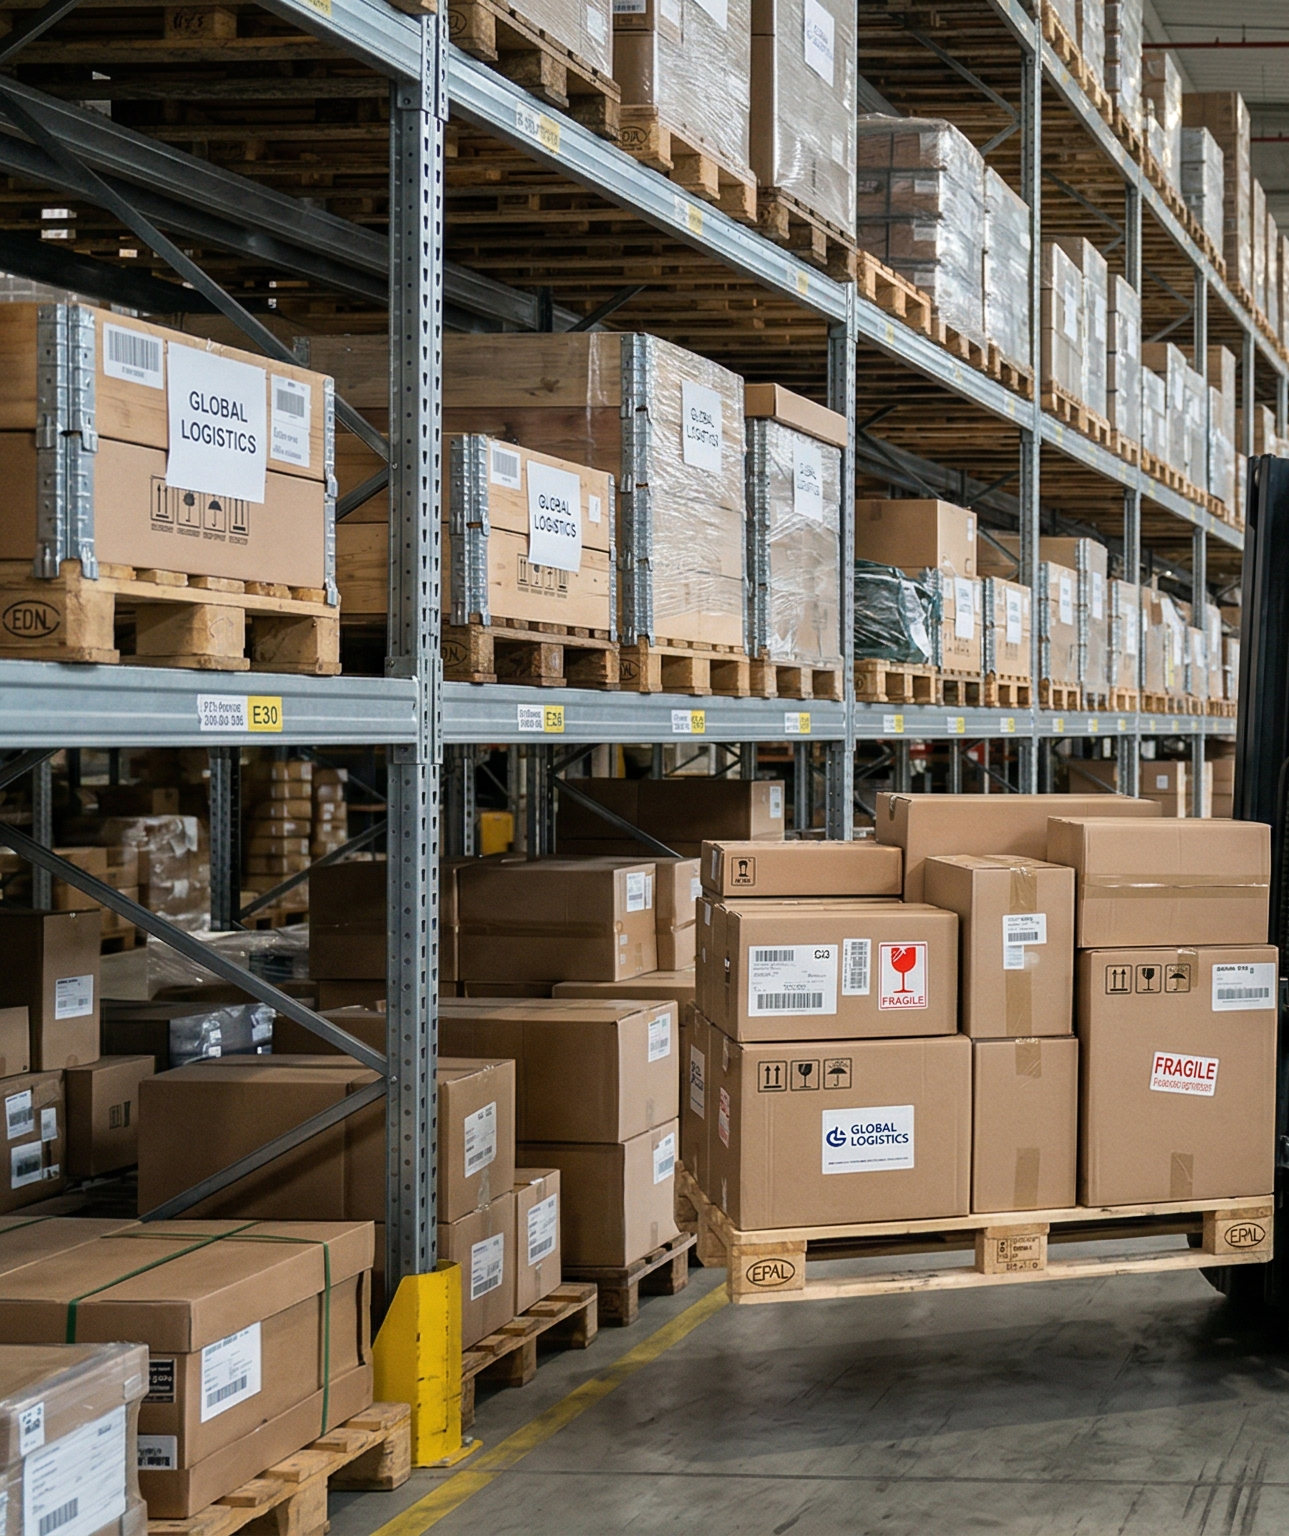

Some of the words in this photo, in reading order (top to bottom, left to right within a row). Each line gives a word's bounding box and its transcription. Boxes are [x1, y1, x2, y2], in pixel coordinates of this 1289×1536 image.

[189, 390, 248, 423] GLOBAL
[181, 419, 256, 454] LOGISTICS
[538, 494, 571, 516] GLOBAL
[534, 514, 577, 538] LOGISTICS
[252, 705, 278, 725] E30
[882, 995, 925, 1006] FRAGILE
[1154, 1056, 1216, 1080] FRAGILE
[850, 1122, 897, 1135] GLOBAL
[850, 1133, 909, 1147] LOGISTICS
[752, 1262, 789, 1282] EPAL
